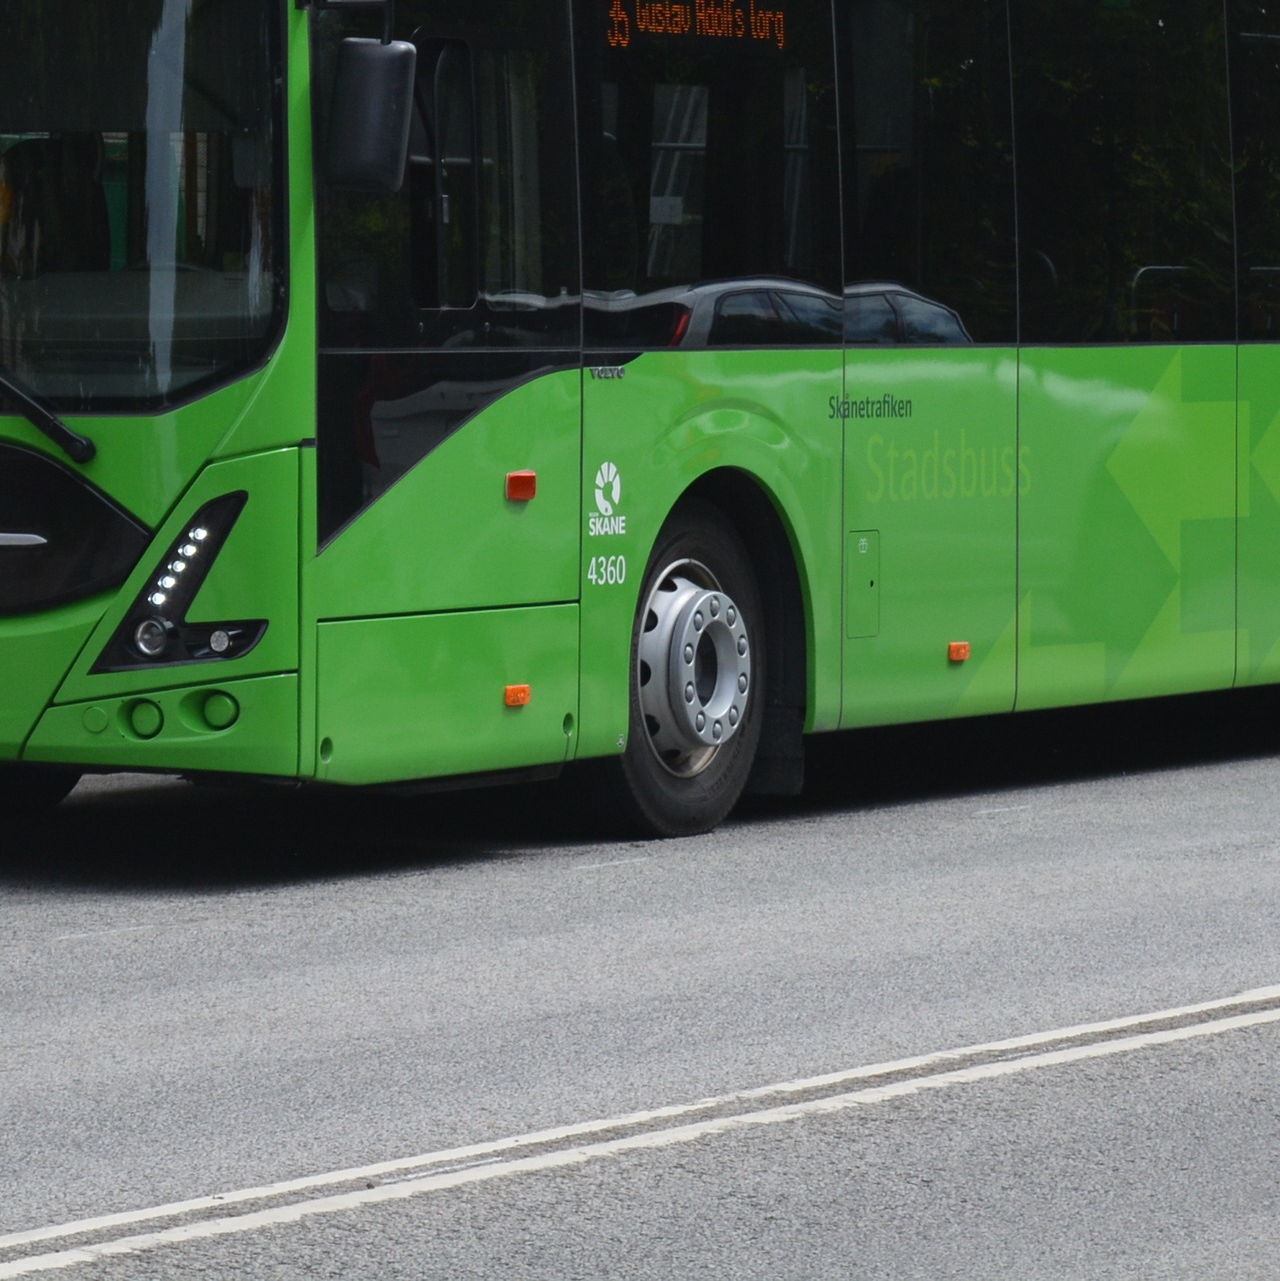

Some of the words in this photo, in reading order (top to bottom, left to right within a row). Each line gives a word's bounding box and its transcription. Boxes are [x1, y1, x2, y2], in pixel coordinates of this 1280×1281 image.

[828, 392, 913, 420] Skånetrafiken
[865, 428, 1032, 504] Stadsbuss
[586, 554, 627, 586] 4360
